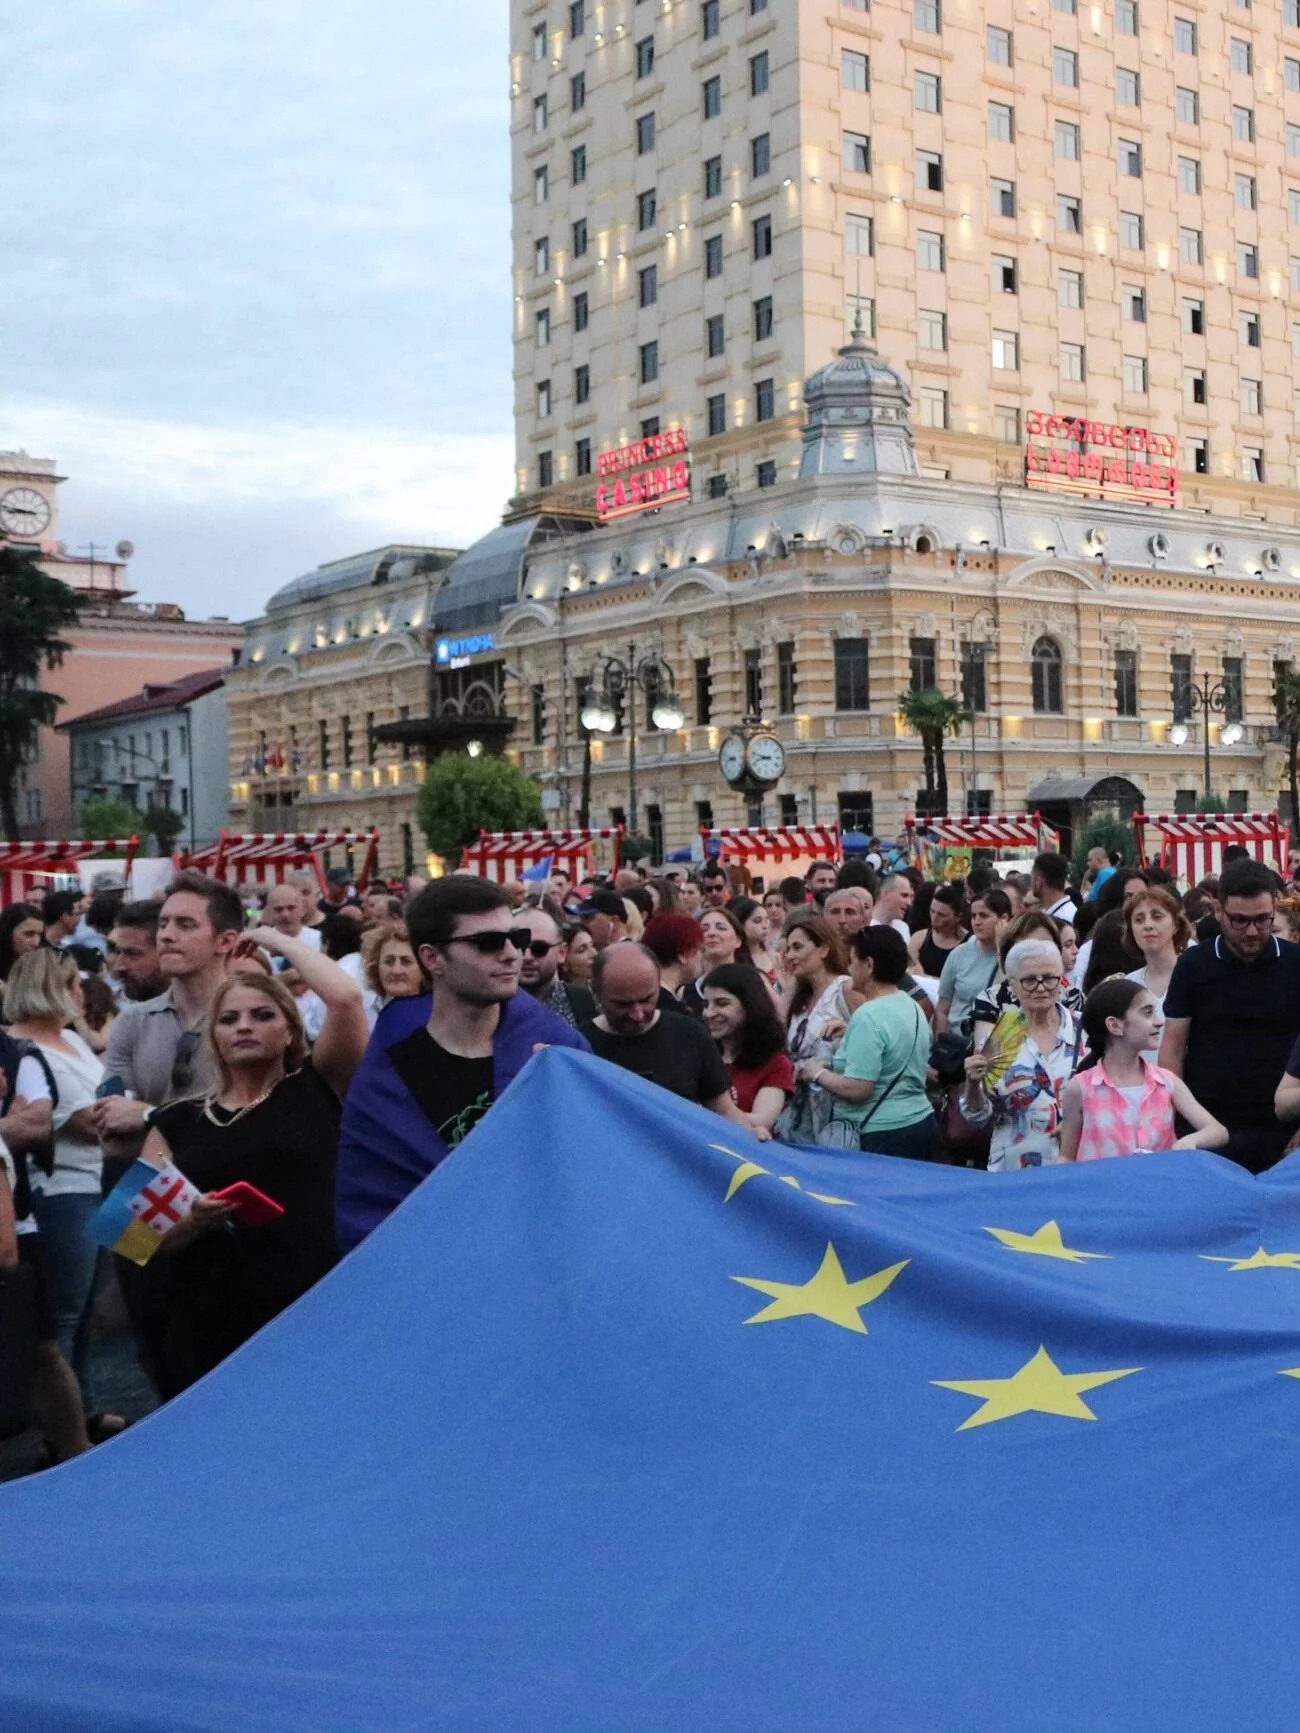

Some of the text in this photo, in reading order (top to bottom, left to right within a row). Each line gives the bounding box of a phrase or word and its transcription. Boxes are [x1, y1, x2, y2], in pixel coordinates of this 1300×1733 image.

[597, 427, 688, 477] PRINCESS
[596, 460, 689, 513] CASINO
[449, 634, 496, 656] WYNDHA
